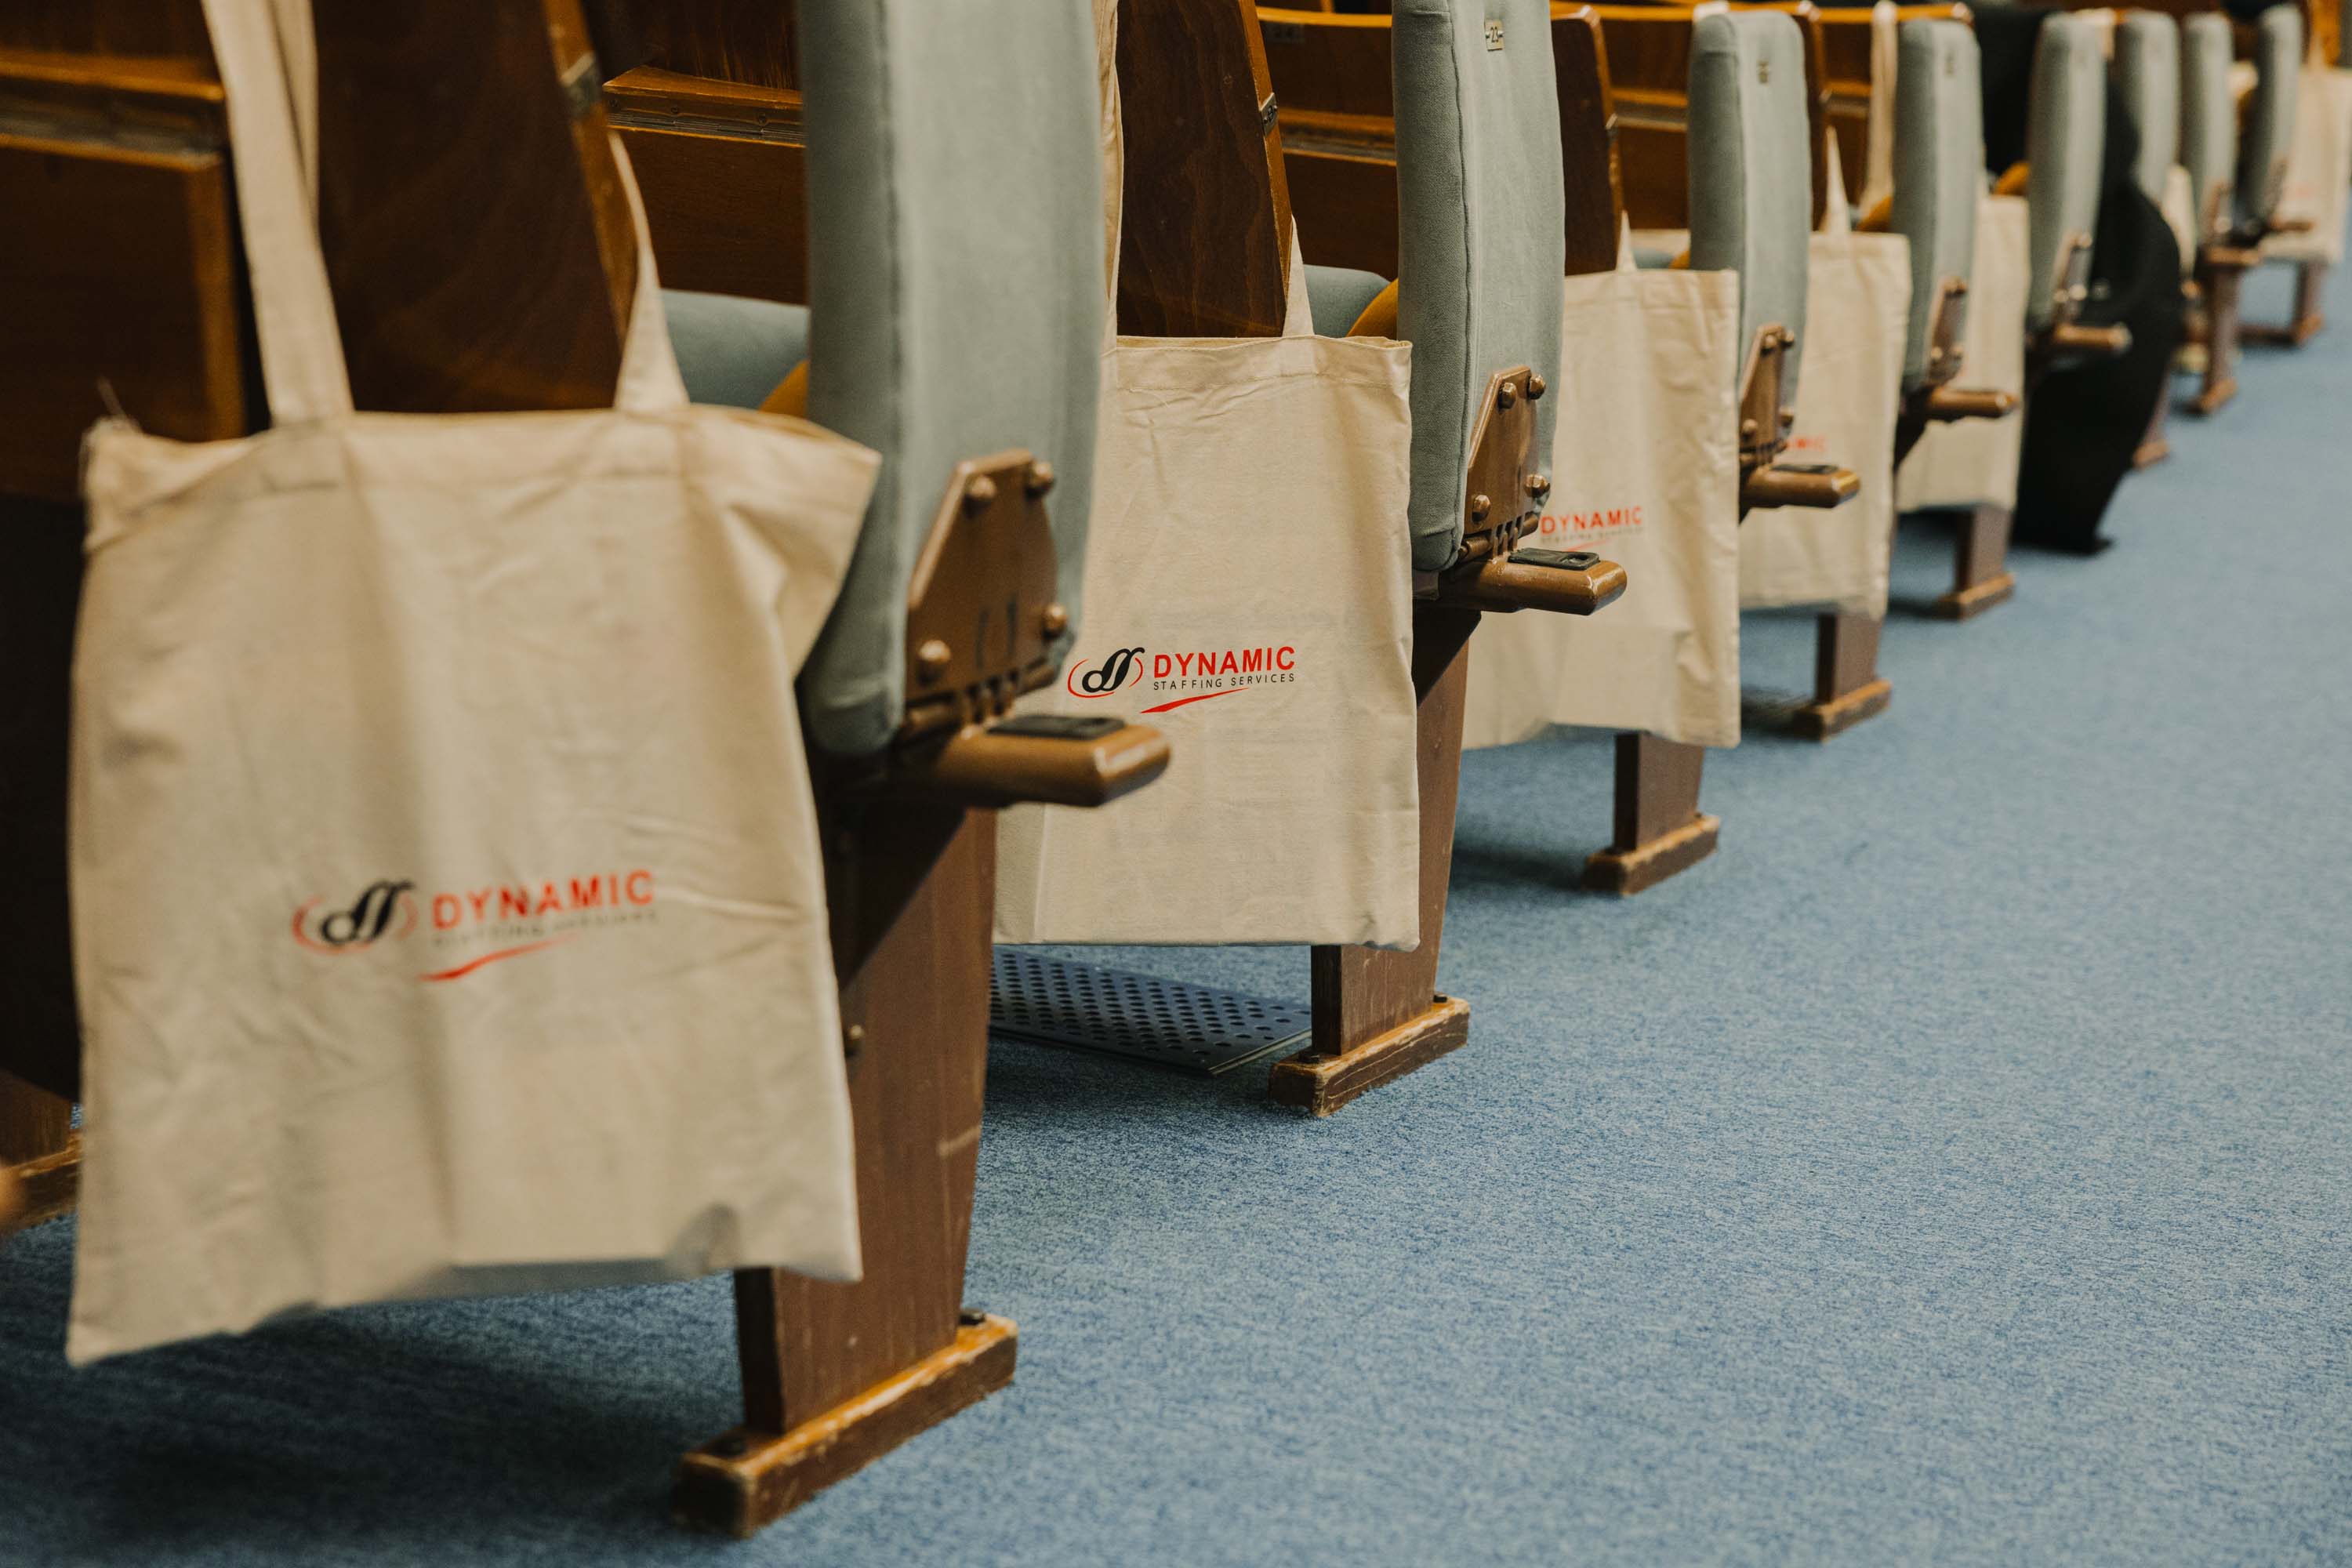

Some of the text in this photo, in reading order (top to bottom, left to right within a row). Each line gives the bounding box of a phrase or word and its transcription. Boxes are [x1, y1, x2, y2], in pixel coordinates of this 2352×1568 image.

[1541, 505, 1642, 535] DYNAMIC
[1154, 646, 1295, 678] DYNAMIC
[1153, 673, 1294, 691] STAFFING SERVICES
[432, 869, 653, 931] DYNAMIC
